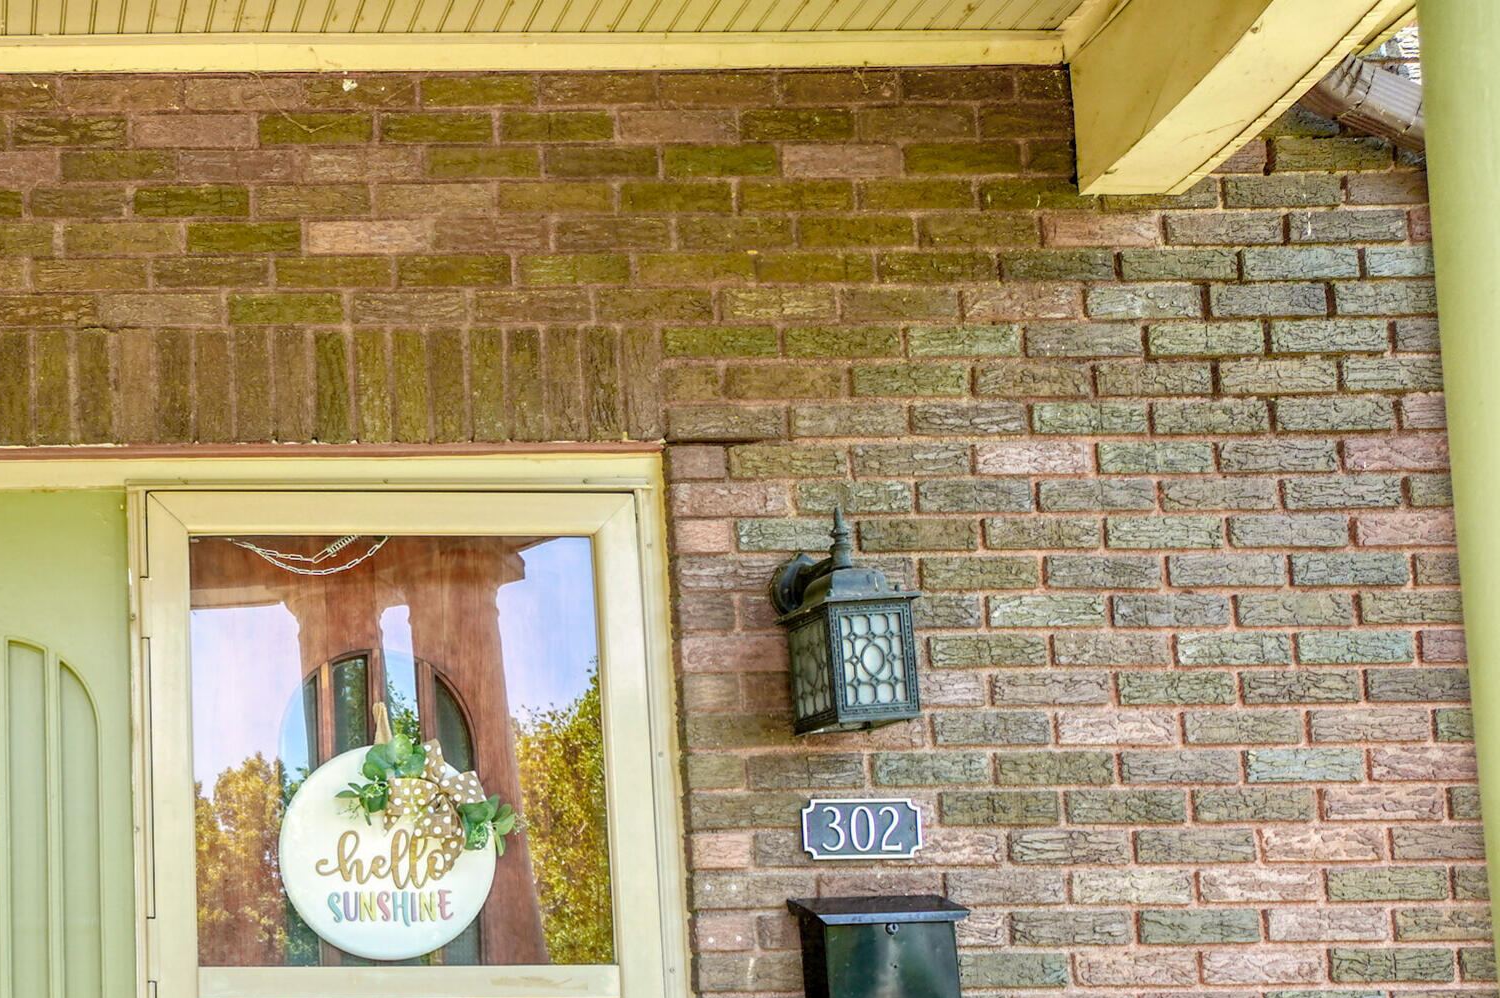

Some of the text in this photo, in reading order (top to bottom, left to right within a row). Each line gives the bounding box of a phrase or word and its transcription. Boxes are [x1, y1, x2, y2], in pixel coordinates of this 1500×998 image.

[821, 806, 902, 851] 302
[315, 829, 449, 889] hello
[327, 889, 454, 927] SUNSHINE
